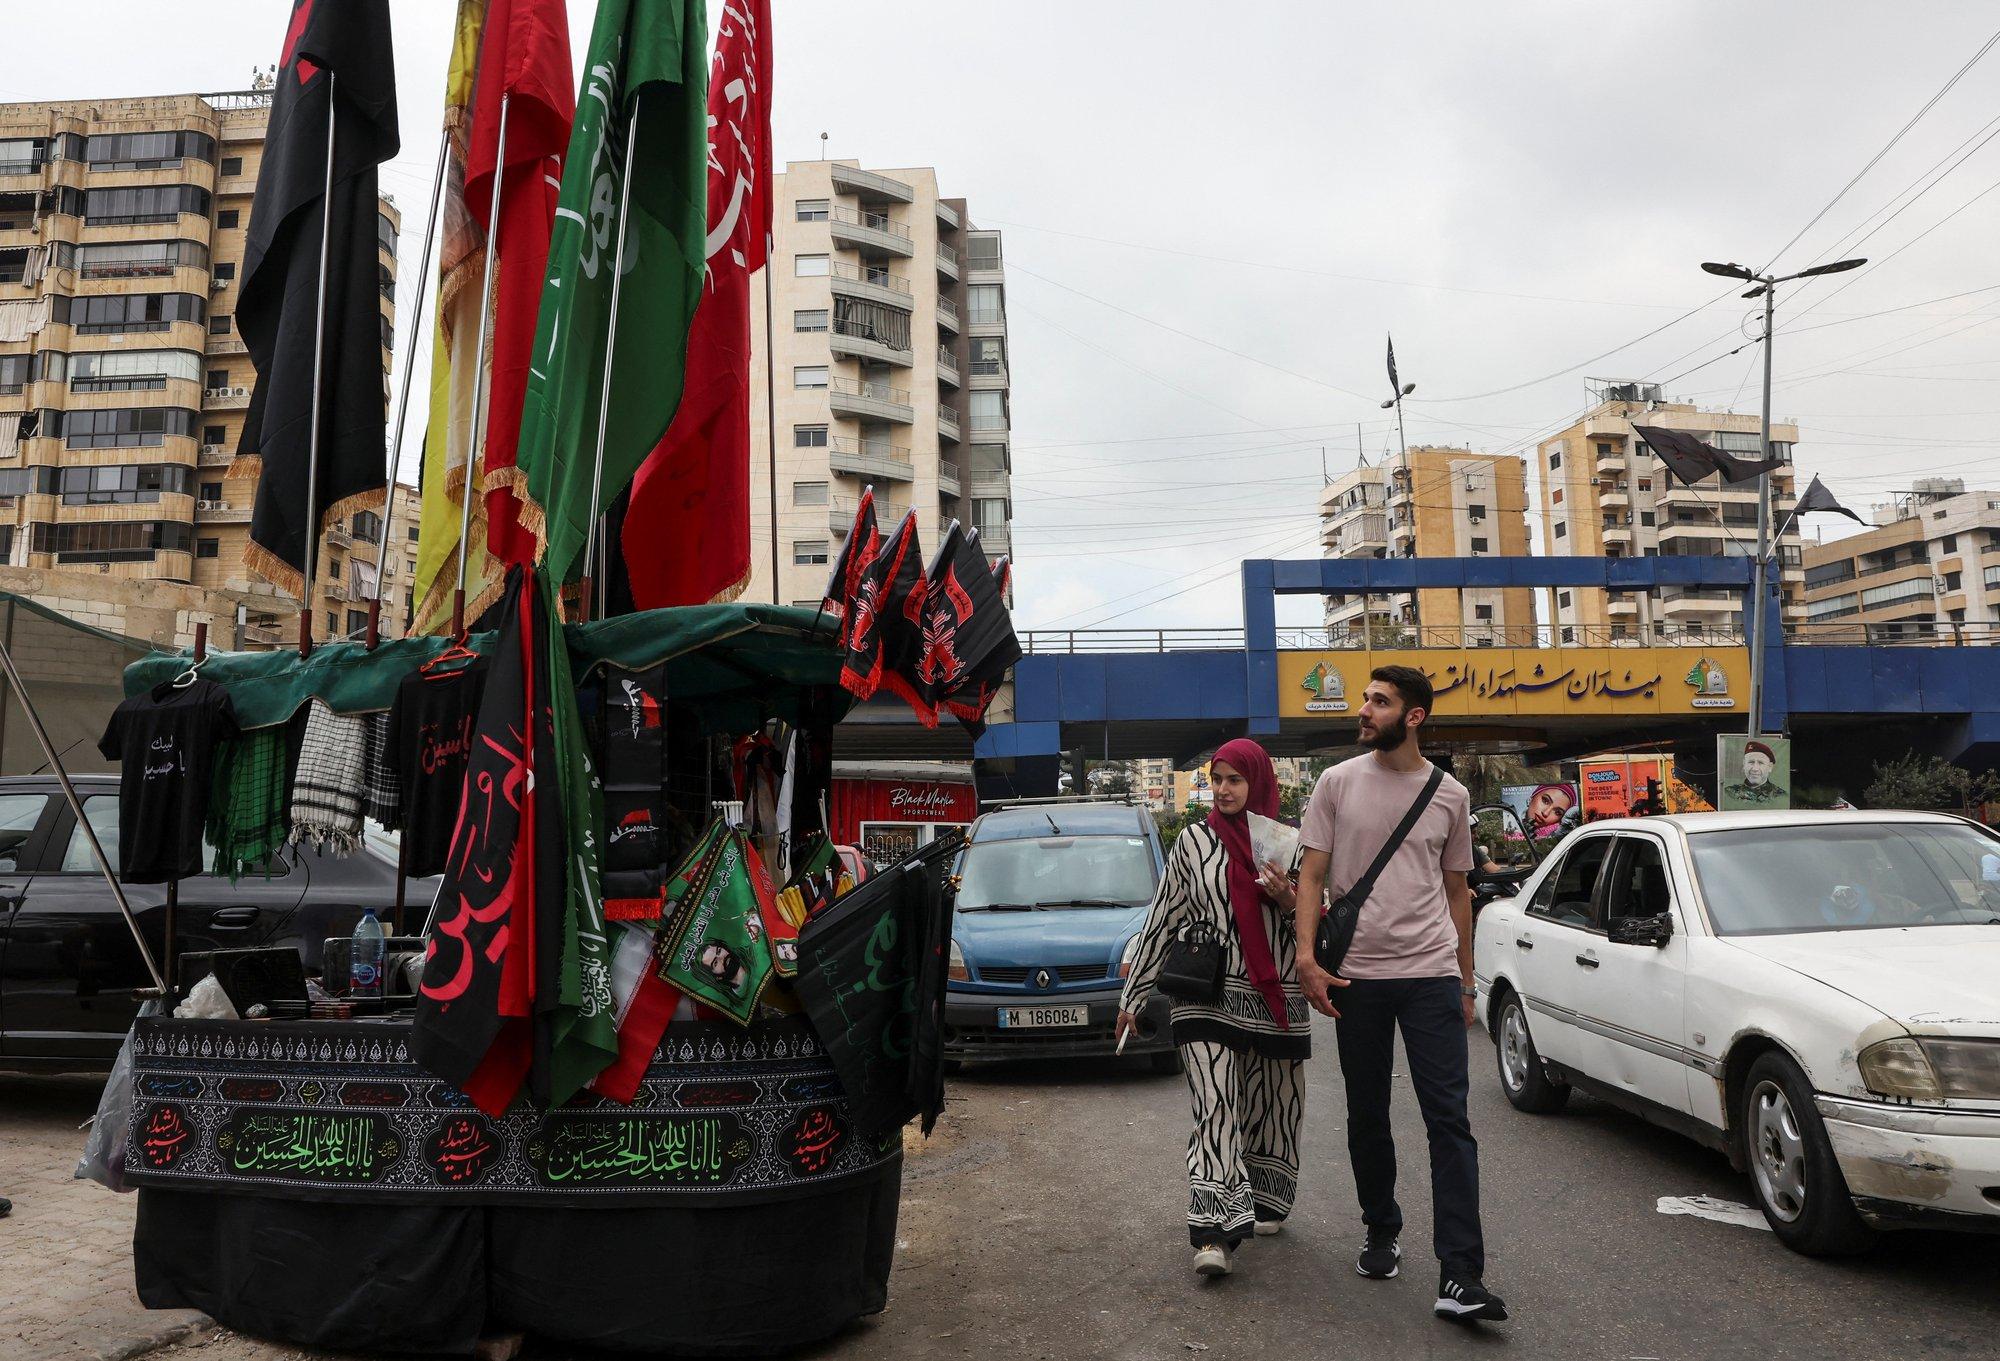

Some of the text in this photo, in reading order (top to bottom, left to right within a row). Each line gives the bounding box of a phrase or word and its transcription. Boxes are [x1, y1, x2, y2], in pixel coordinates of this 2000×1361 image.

[1477, 663, 1575, 699] شهداء
[1566, 669, 1662, 699] ميدان
[151, 734, 173, 752] لبيك
[1593, 775, 1620, 783] BONJOUR
[1009, 1009, 1079, 1025] M 186084
